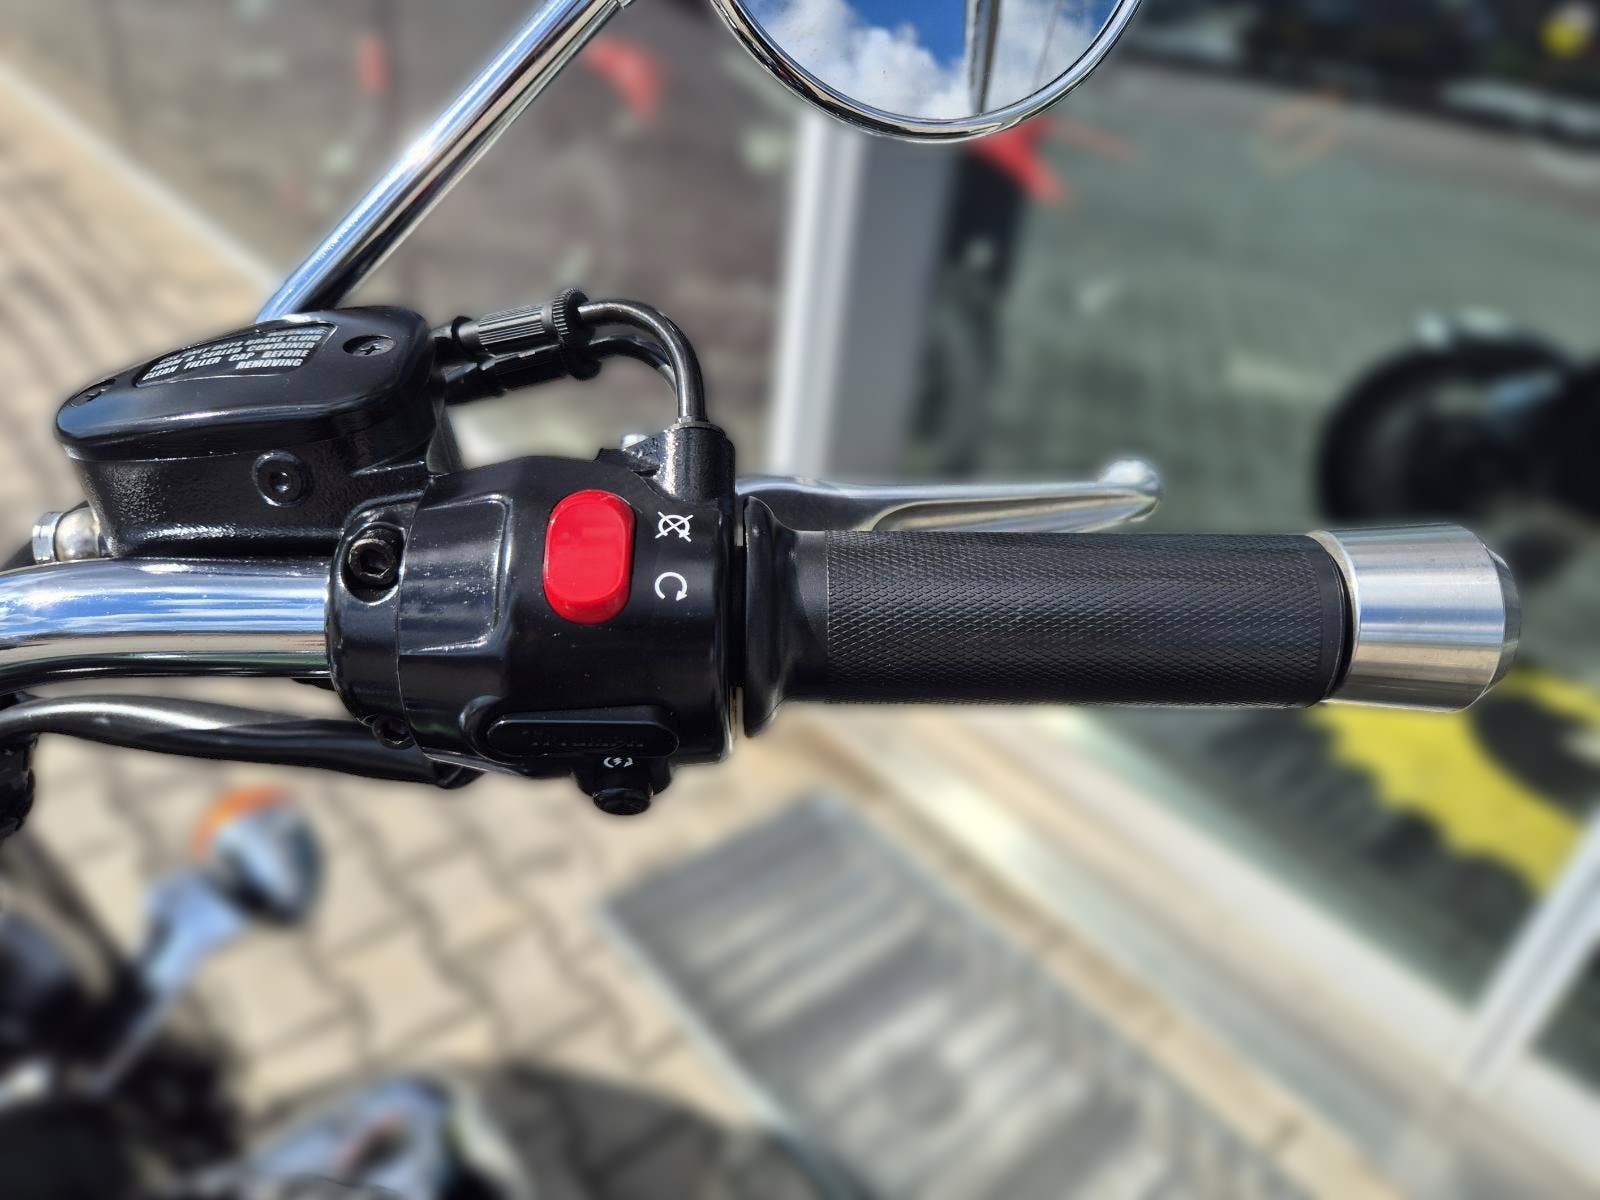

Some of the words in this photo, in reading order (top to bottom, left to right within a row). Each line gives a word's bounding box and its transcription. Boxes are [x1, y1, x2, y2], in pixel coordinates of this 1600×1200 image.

[199, 347, 243, 359] SEALED
[246, 342, 316, 352] CONTAINER
[142, 365, 179, 380] CLEAN
[184, 357, 222, 369] FILLER
[228, 352, 255, 362] CAP
[261, 349, 310, 358] BEFORE
[235, 358, 303, 370] REMOVING
